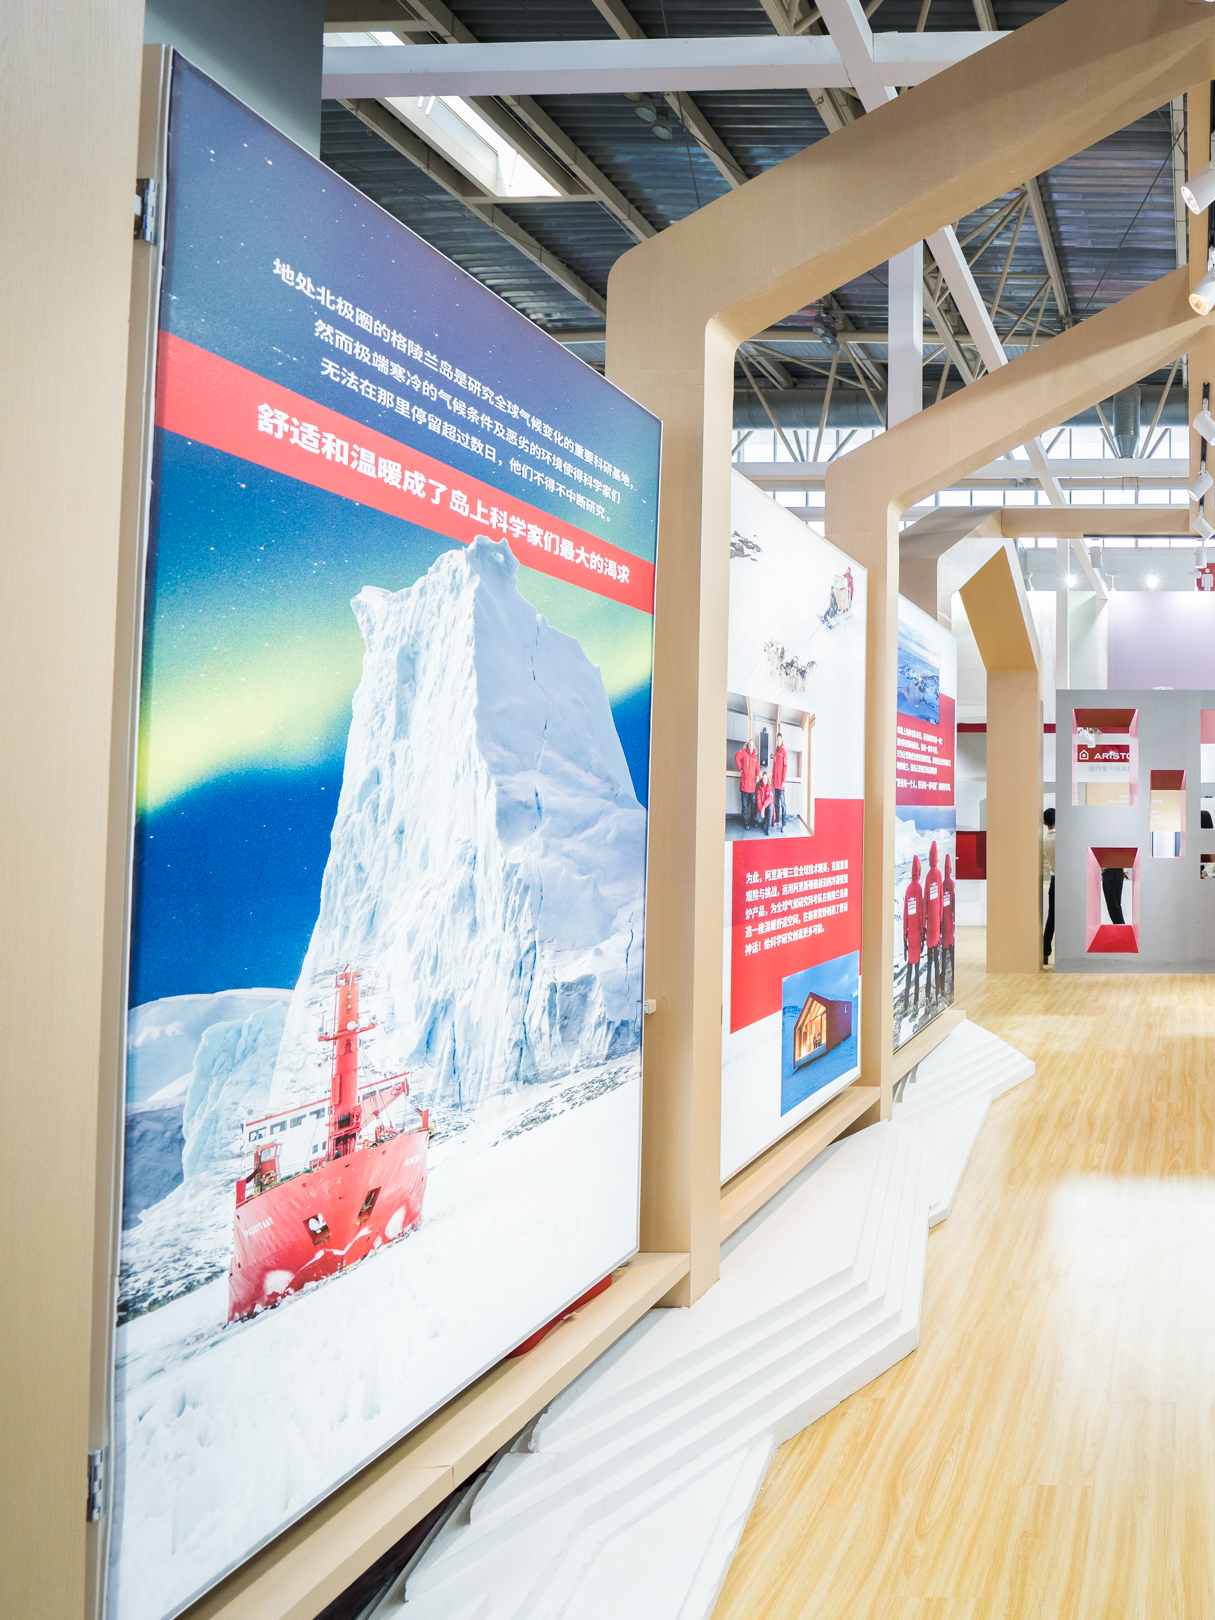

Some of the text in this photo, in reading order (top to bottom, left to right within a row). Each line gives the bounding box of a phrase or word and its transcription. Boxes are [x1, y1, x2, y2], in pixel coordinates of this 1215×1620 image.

[257, 403, 631, 584] 舒适和温暖成了岛上科学家们最大的渴求
[314, 319, 621, 504] 然而极端寒冷的气候条件及恶劣的环境使得科学家们
